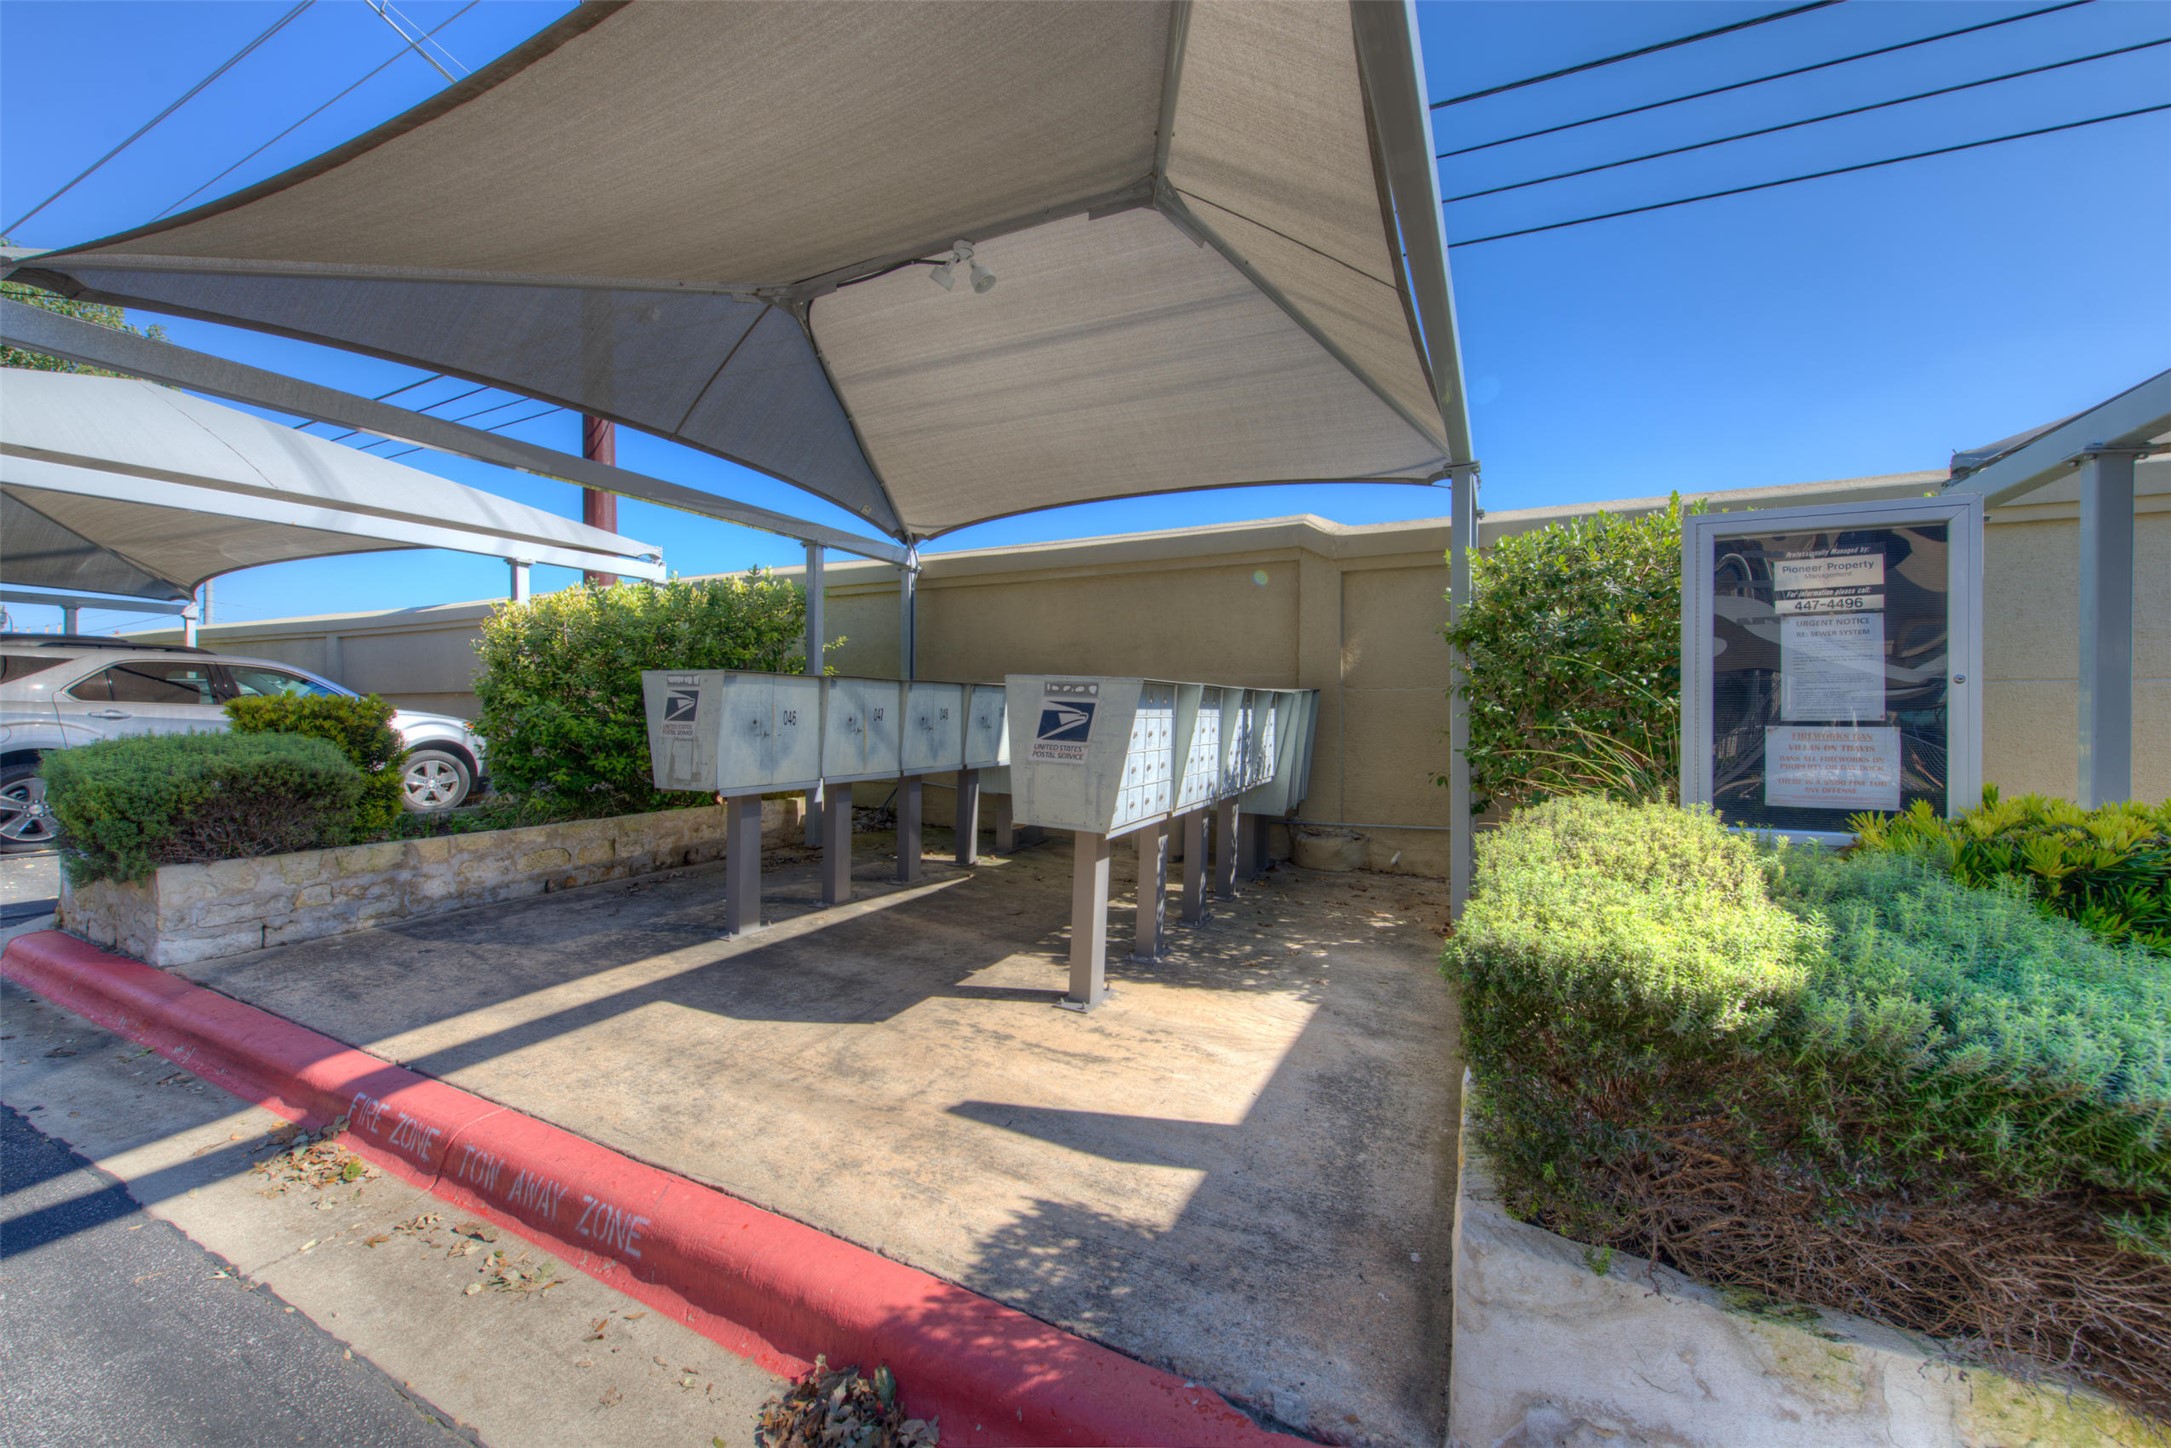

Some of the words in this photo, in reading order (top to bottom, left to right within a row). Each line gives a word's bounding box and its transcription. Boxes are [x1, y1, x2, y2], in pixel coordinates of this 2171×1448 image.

[1786, 550, 1829, 558] Professionally
[1830, 547, 1858, 555] Managed
[1783, 565, 1822, 574] Pioneer
[1827, 560, 1874, 571] Property
[1798, 589, 1832, 597] information
[1835, 588, 1855, 596] please
[1795, 598, 1864, 611] 447-4496
[1836, 617, 1872, 625] NOTICE
[1792, 732, 1849, 741] FIREWORKS
[1032, 751, 1056, 759] POSTAL
[346, 1092, 390, 1134] FIRE
[388, 1112, 442, 1162] ZONE
[458, 1143, 505, 1192] TOW
[507, 1168, 569, 1224] AWAY
[575, 1194, 650, 1258] ZONE
